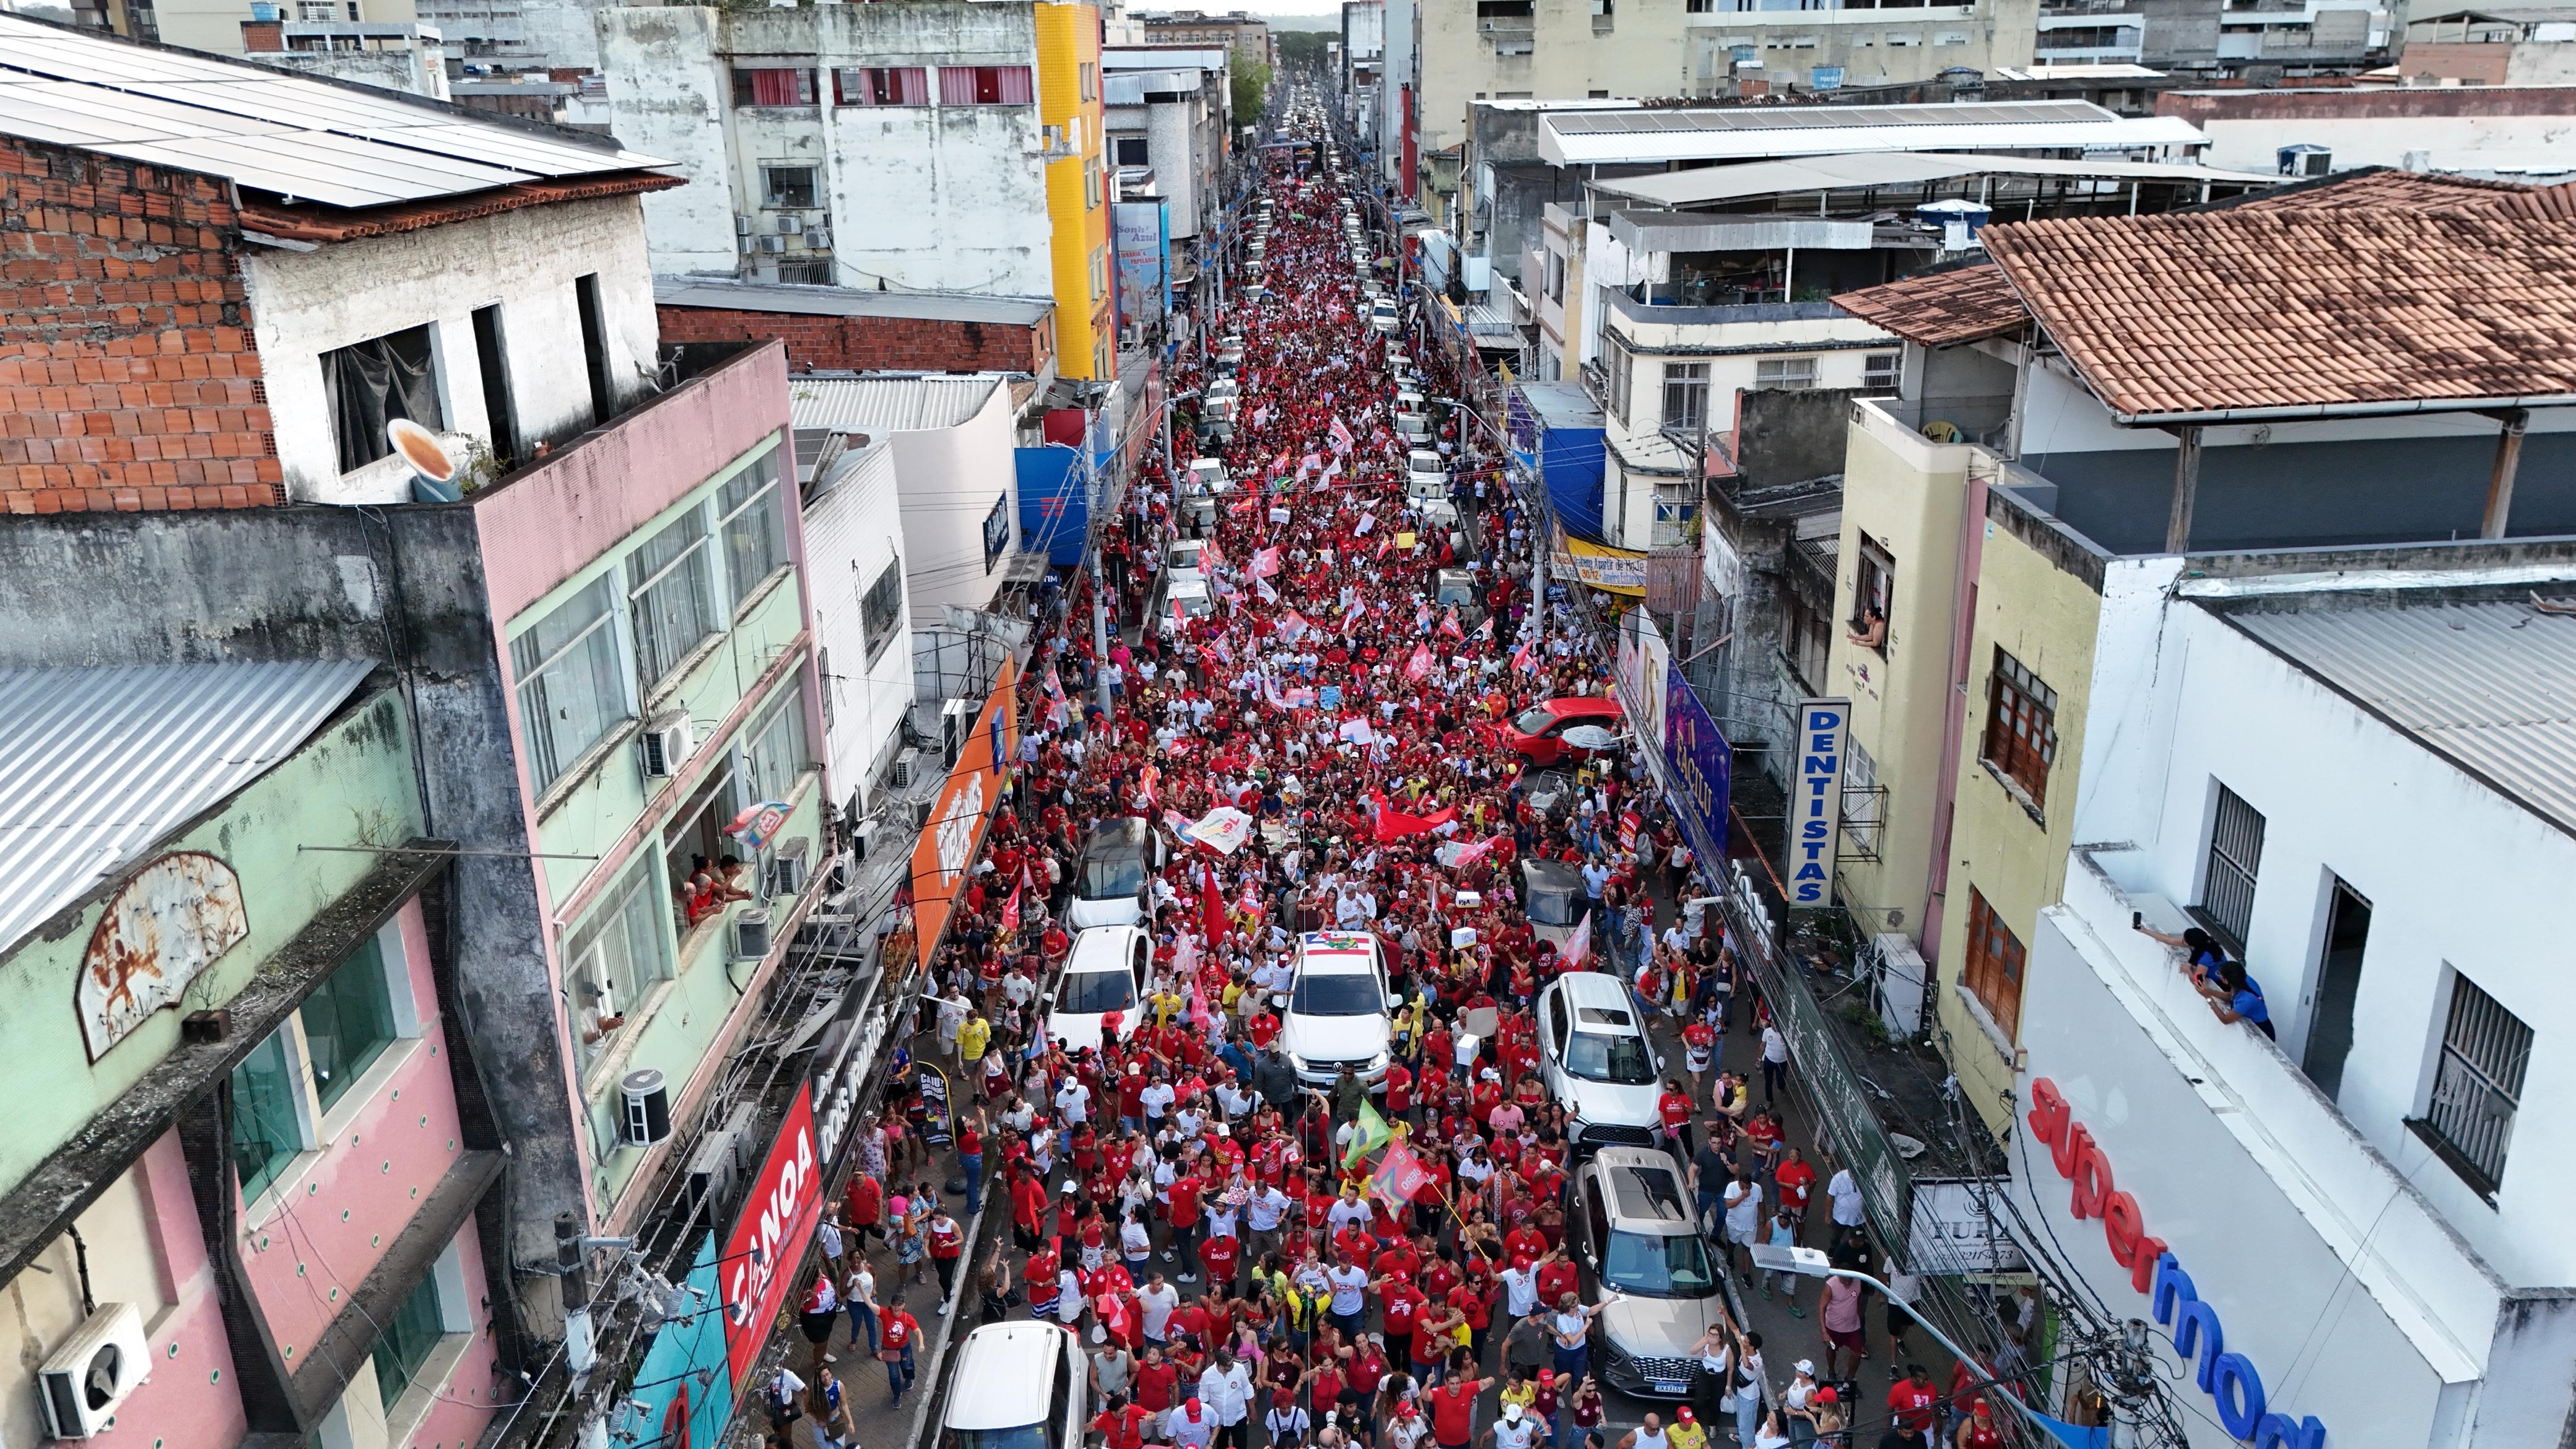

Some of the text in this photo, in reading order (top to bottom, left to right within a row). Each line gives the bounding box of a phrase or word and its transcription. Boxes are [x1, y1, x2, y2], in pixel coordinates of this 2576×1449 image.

[1129, 257, 1157, 265] PAPELARIA
[1131, 233, 1157, 242] Azul
[1794, 711, 1840, 902] DENTISTAS
[845, 1004, 886, 1104] IRMÃOS
[920, 1073, 944, 1087] CAIU?
[820, 1087, 850, 1164] DOIS
[775, 1199, 802, 1261] VIRADA
